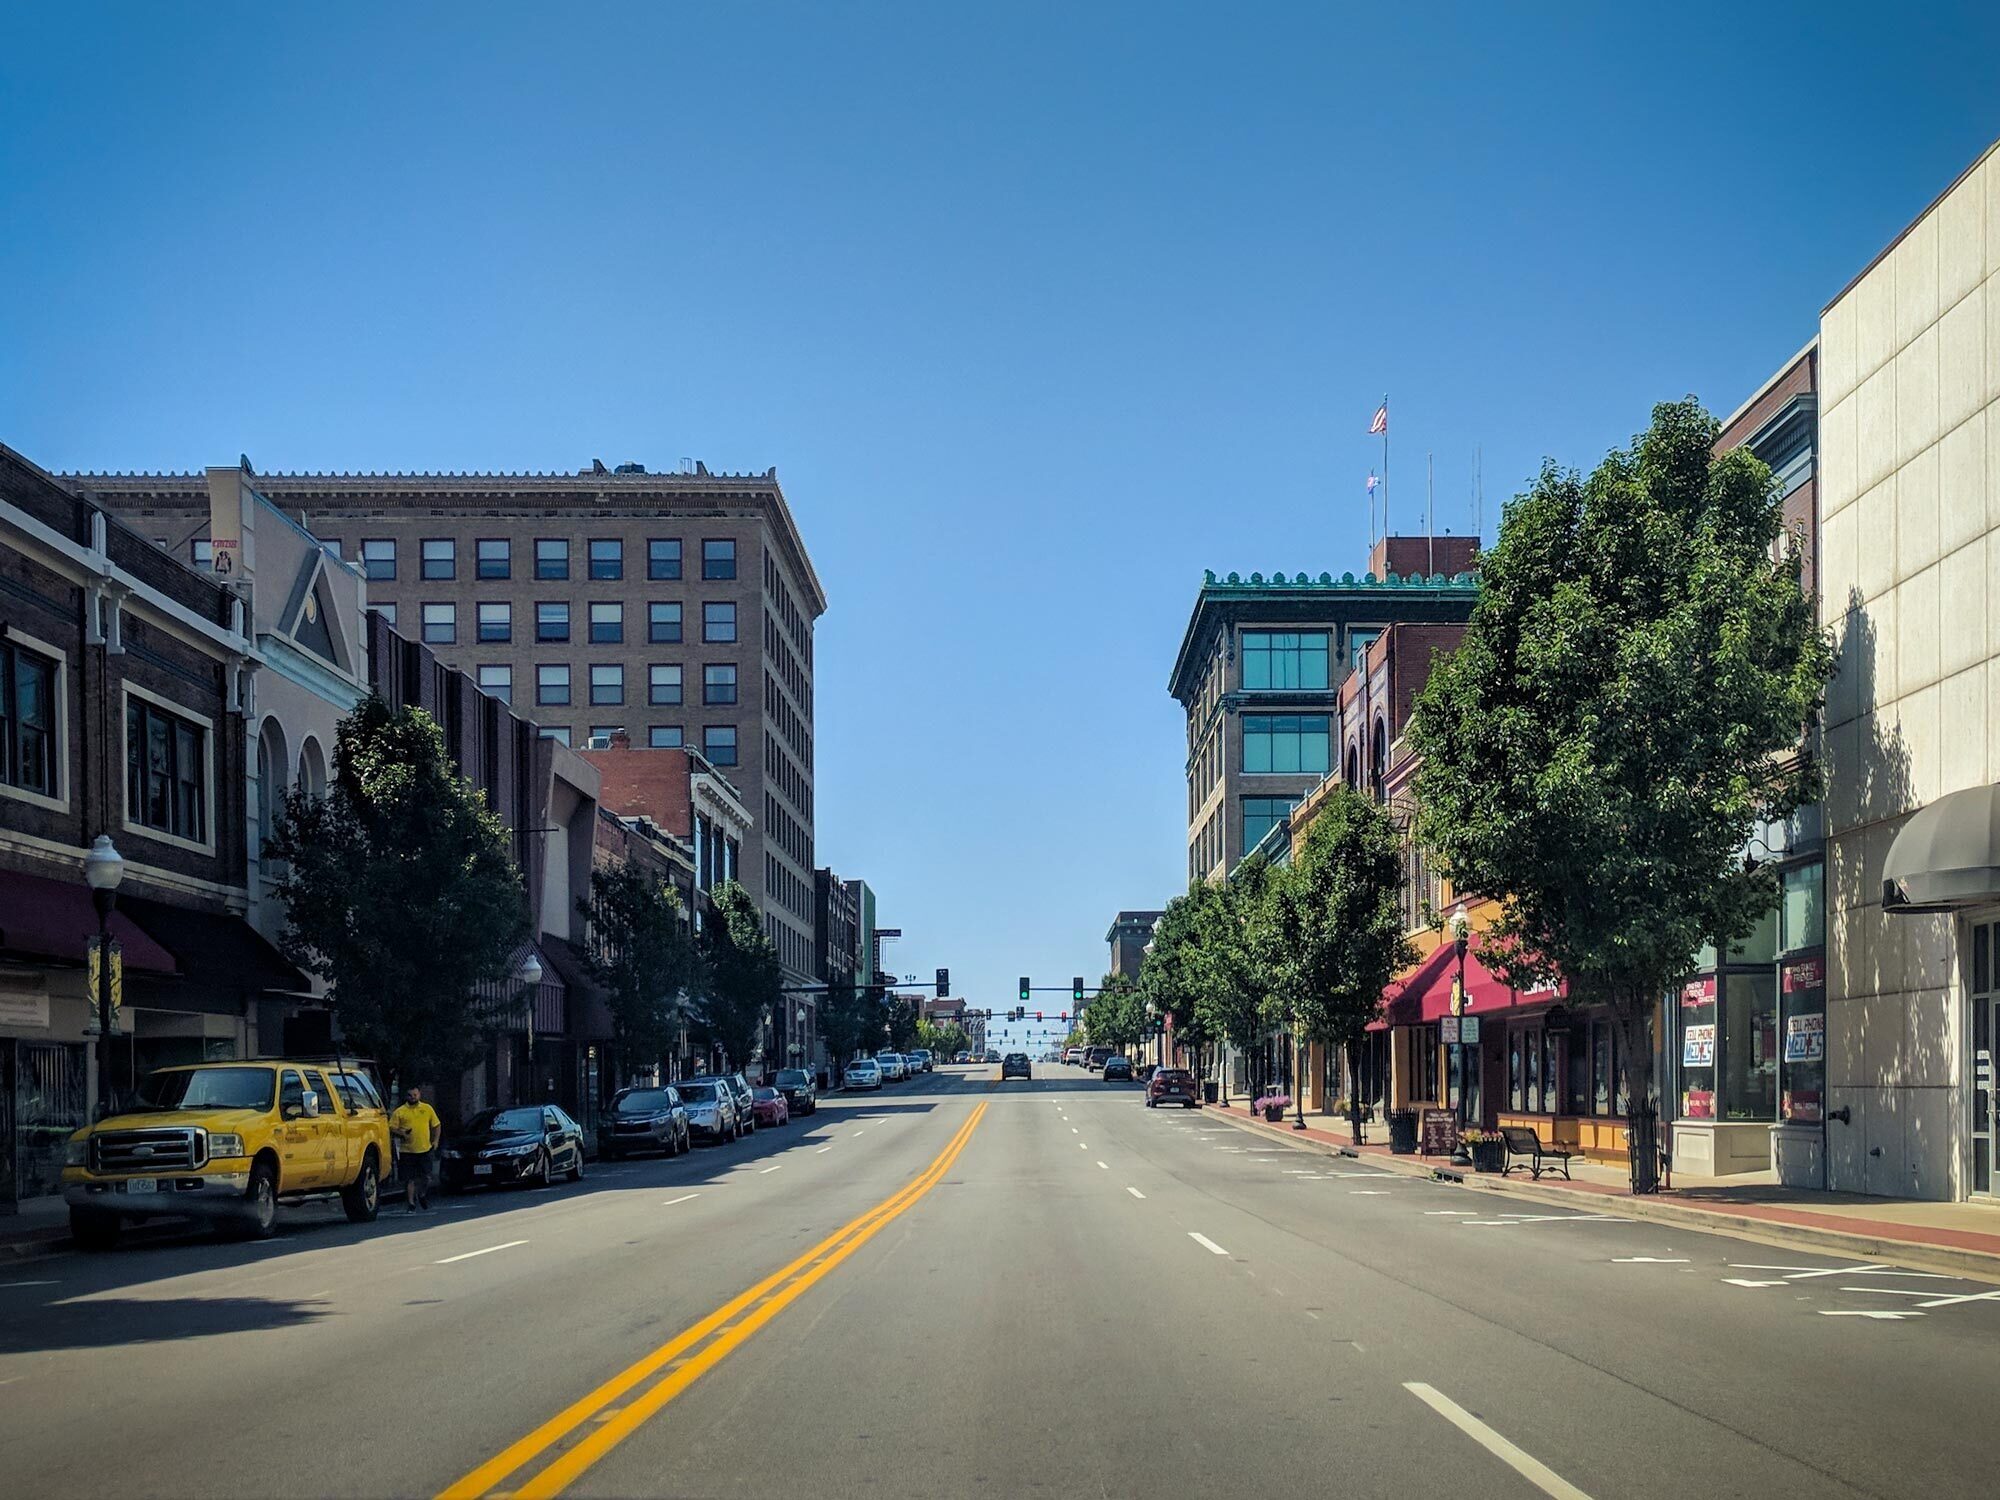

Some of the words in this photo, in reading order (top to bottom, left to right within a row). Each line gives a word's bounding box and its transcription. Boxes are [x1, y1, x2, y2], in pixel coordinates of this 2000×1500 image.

[1790, 1020, 1802, 1032] CELL
[1804, 1018, 1824, 1031] PHONE
[1687, 1029, 1697, 1041] CELL
